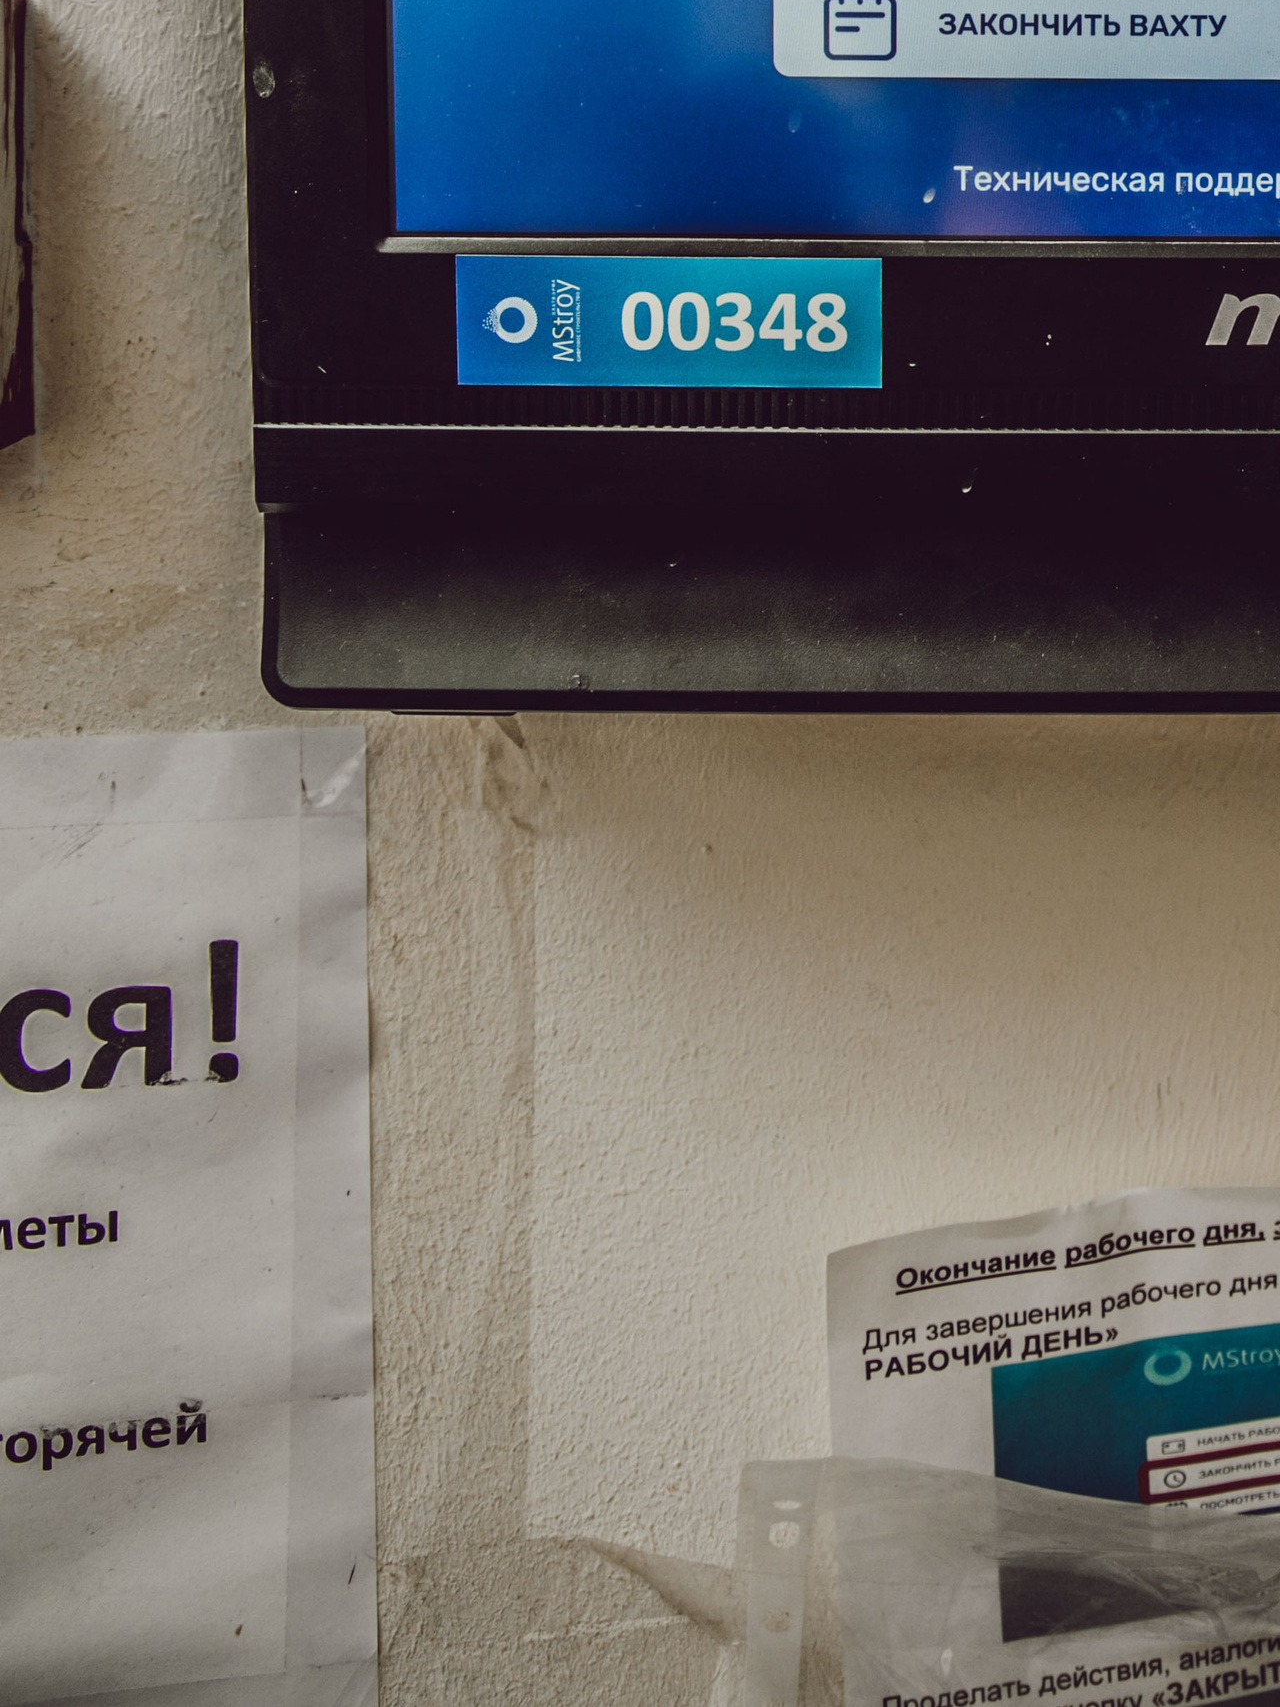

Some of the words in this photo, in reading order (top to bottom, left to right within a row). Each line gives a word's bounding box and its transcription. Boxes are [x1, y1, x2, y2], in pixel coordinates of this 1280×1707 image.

[938, 11, 1121, 38] ЗАКОНЧИТЬ
[1129, 14, 1228, 39] ВАХТУ
[953, 165, 1165, 194] Техническая
[552, 279, 580, 362] MStroy
[621, 291, 848, 352] 00348
[0, 940, 240, 1093] ся!
[896, 1247, 1057, 1295] Окончание
[1064, 1224, 1196, 1269] рабочего
[1202, 1220, 1265, 1246] дня,
[862, 1328, 917, 1355] Для
[926, 1301, 1093, 1341] завершения
[1100, 1280, 1222, 1319] рабочего
[1229, 1272, 1278, 1297] дня
[864, 1334, 1012, 1381] РАБОЧИЙ
[1021, 1326, 1119, 1360] ДЕНЬ»
[0, 1399, 207, 1471] орячей
[1197, 1430, 1246, 1447] НАЧАТЬ
[1198, 1459, 1272, 1480] ЗАКОНЧИТЬ
[1038, 1656, 1171, 1696] действия,
